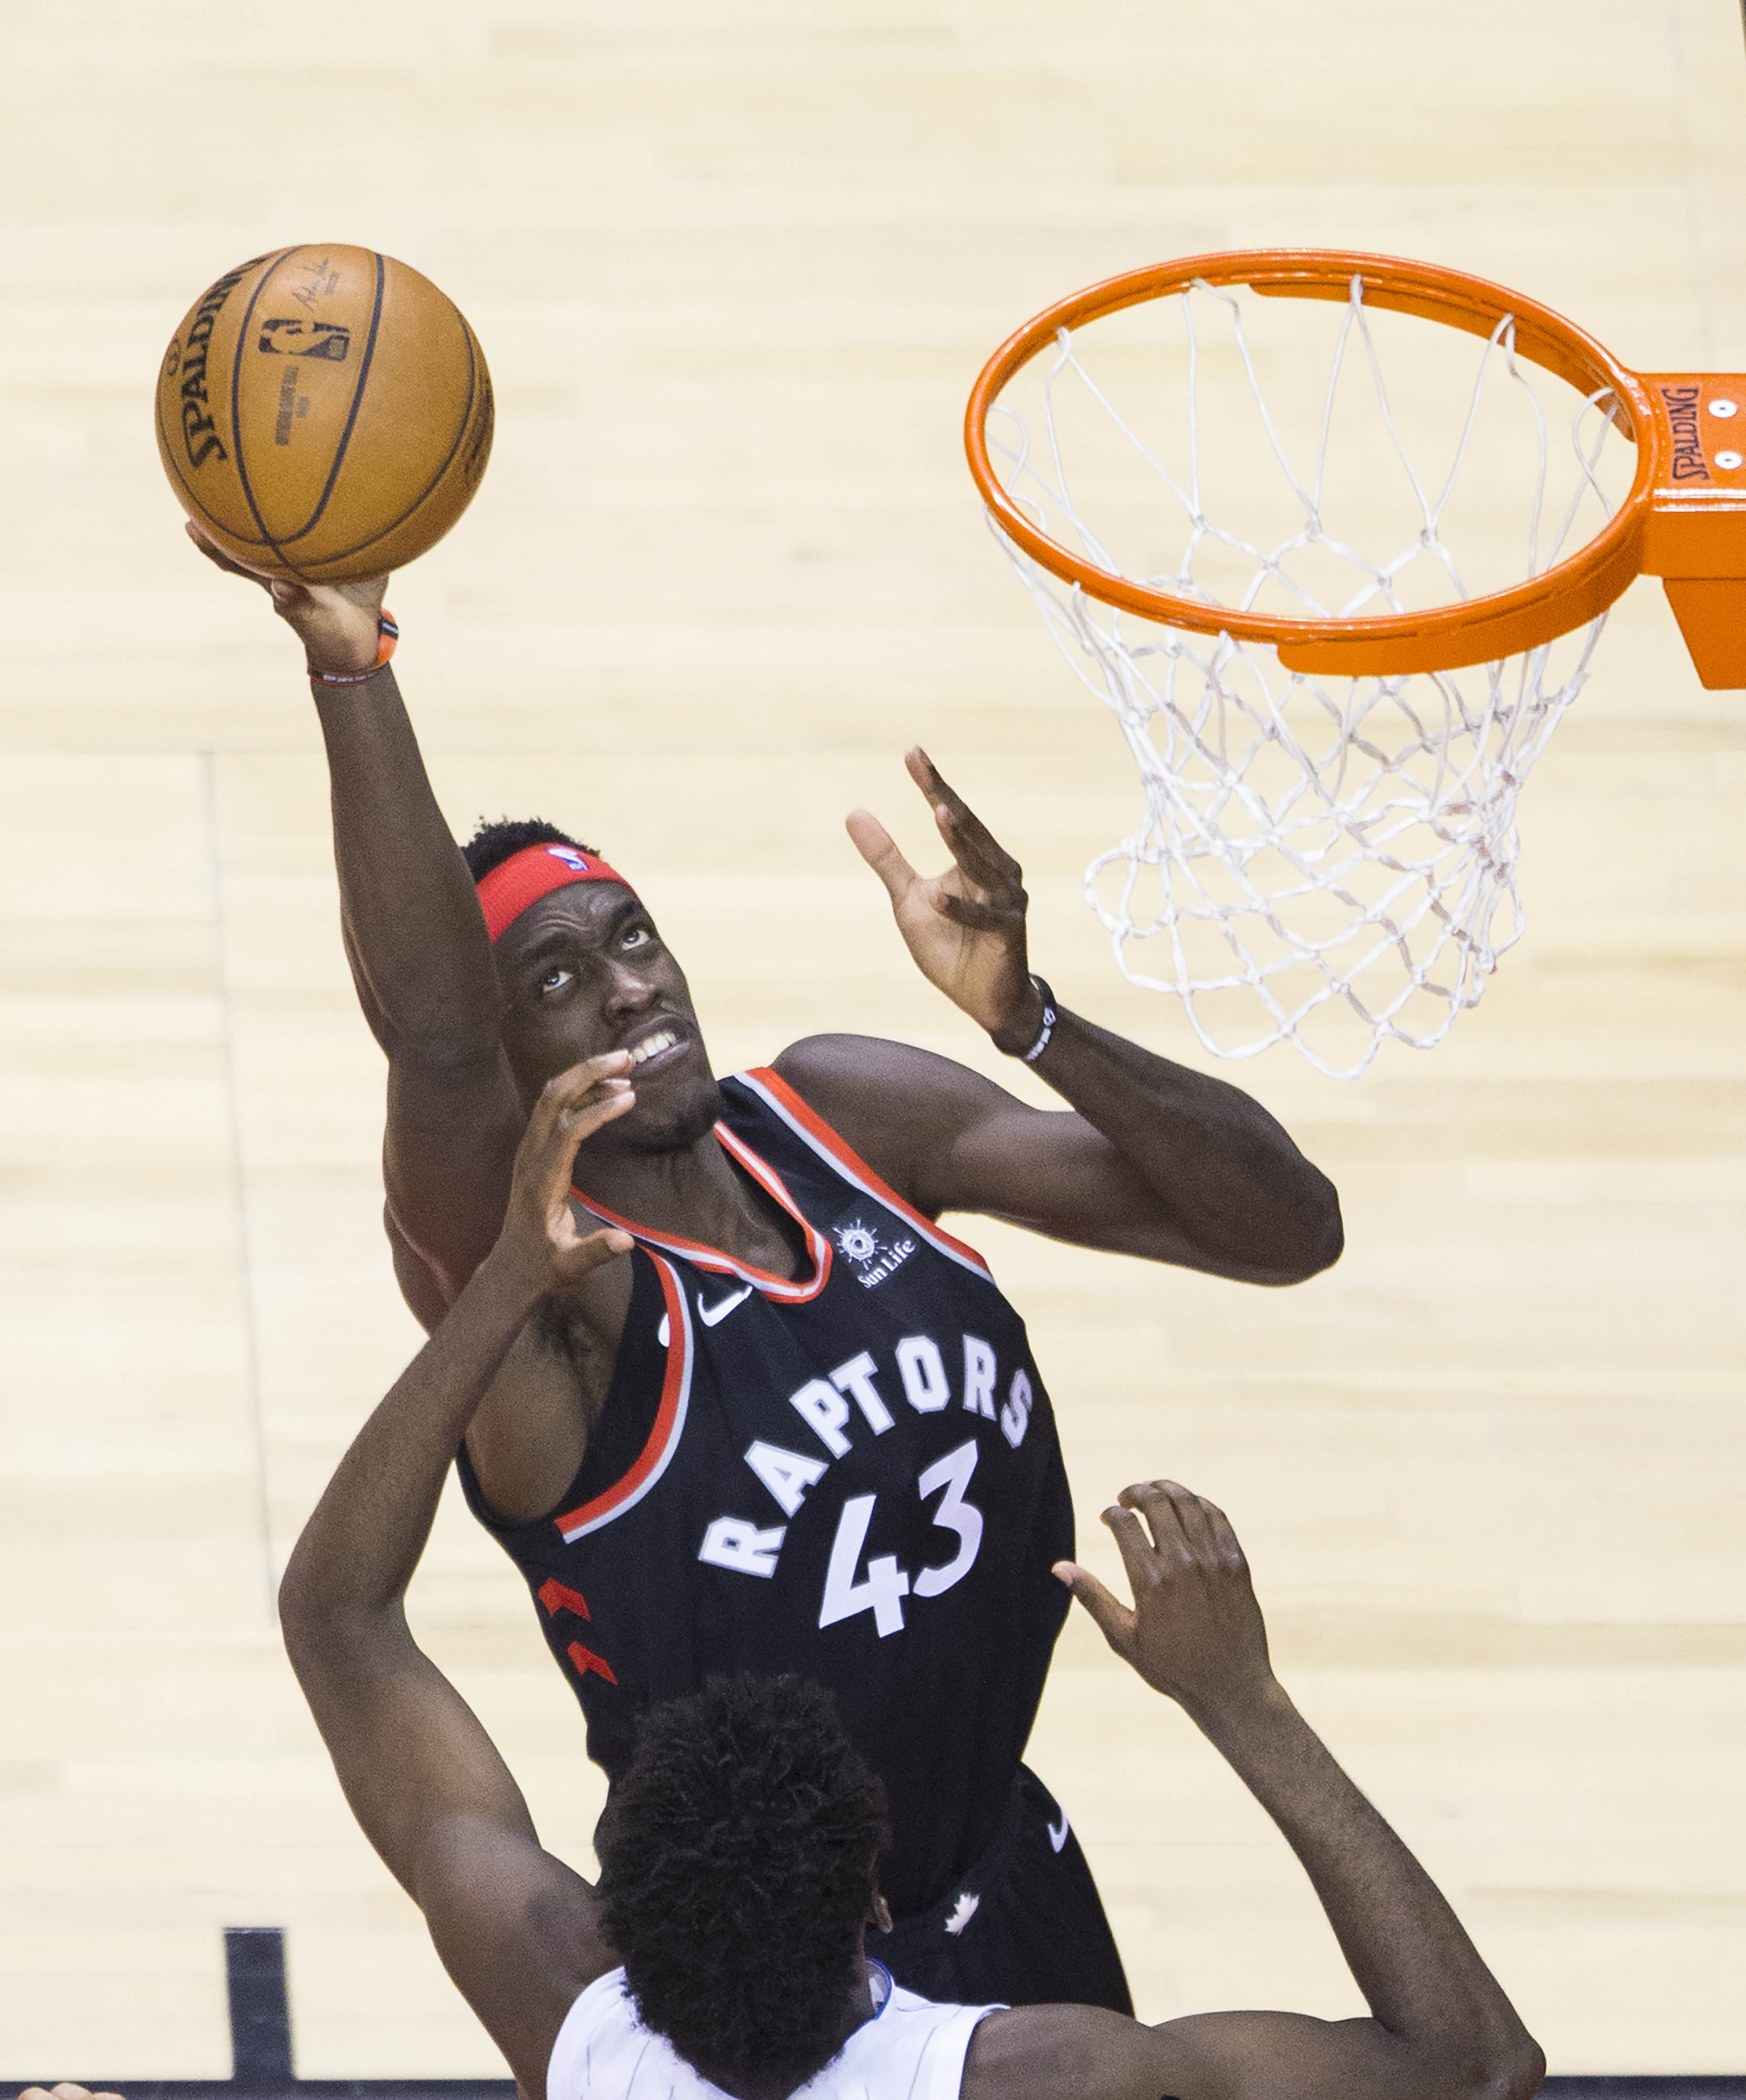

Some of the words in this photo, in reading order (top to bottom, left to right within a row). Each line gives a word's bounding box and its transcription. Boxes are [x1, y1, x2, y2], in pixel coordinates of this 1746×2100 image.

[1661, 388, 1709, 479] SPALDING
[857, 1267, 888, 1289] Sun
[881, 1240, 915, 1272] Life
[697, 1334, 1033, 1579] RAPTORS
[818, 1439, 984, 1638] 43
